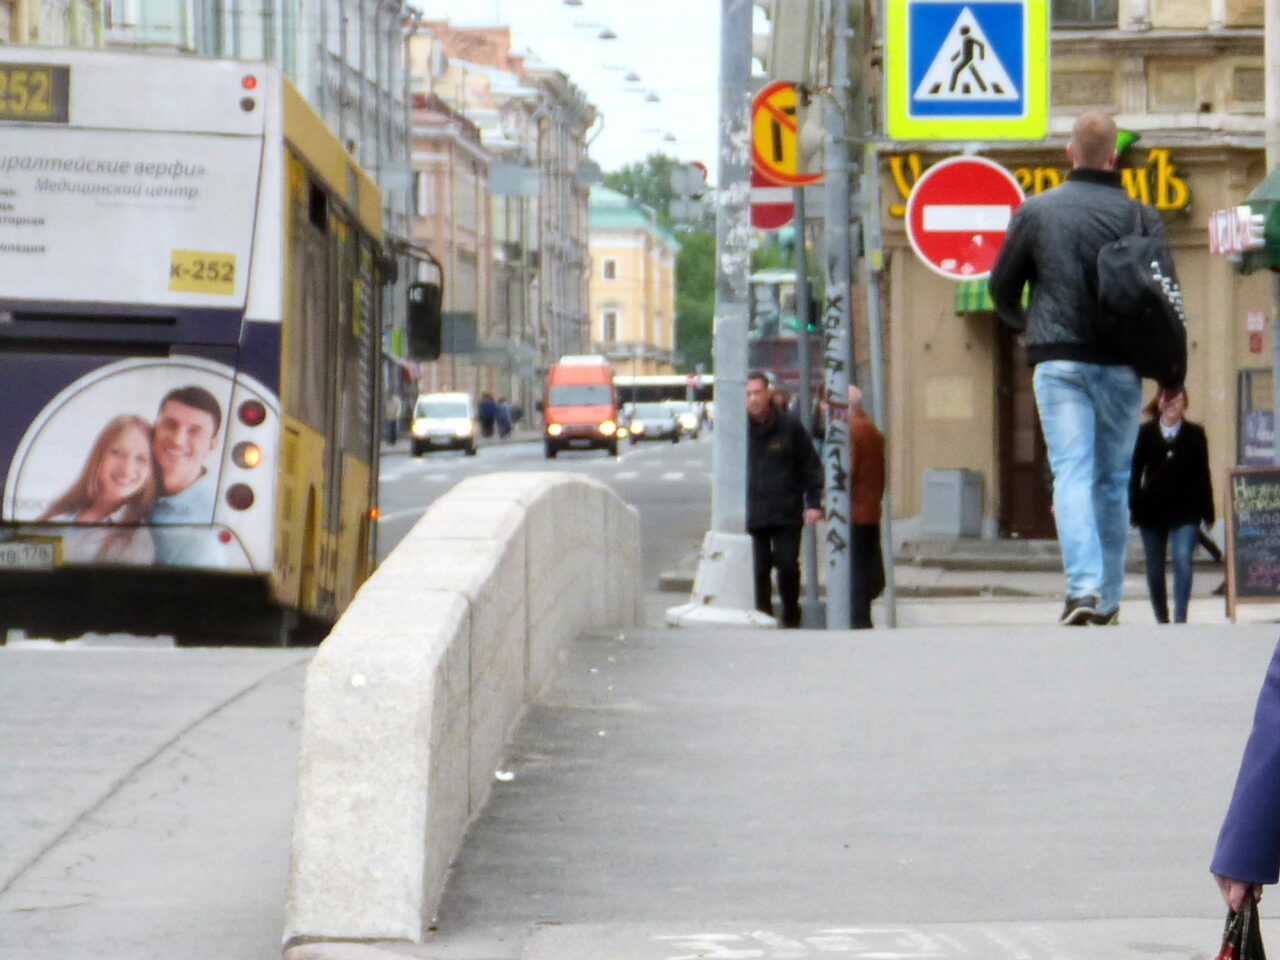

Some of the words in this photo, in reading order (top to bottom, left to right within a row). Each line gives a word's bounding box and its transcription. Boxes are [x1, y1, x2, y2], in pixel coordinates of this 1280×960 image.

[134, 157, 206, 180] верфи»
[34, 176, 142, 197] Медицинский
[145, 183, 199, 201] центр
